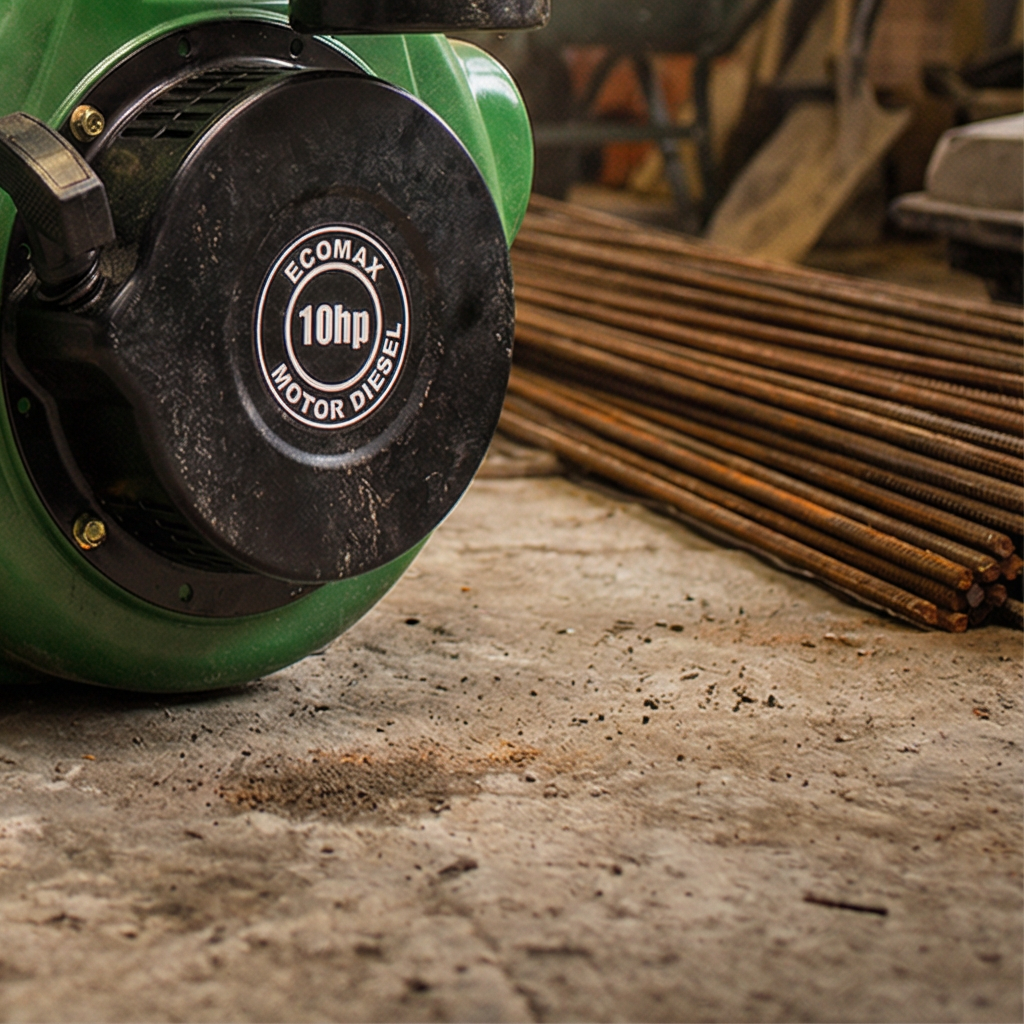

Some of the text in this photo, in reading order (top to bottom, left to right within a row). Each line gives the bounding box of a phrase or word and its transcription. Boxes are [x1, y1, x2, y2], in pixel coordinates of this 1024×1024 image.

[284, 238, 385, 285] ECOMAX
[298, 304, 370, 350] 10hp
[270, 322, 403, 420] MOTOR DIESEL
